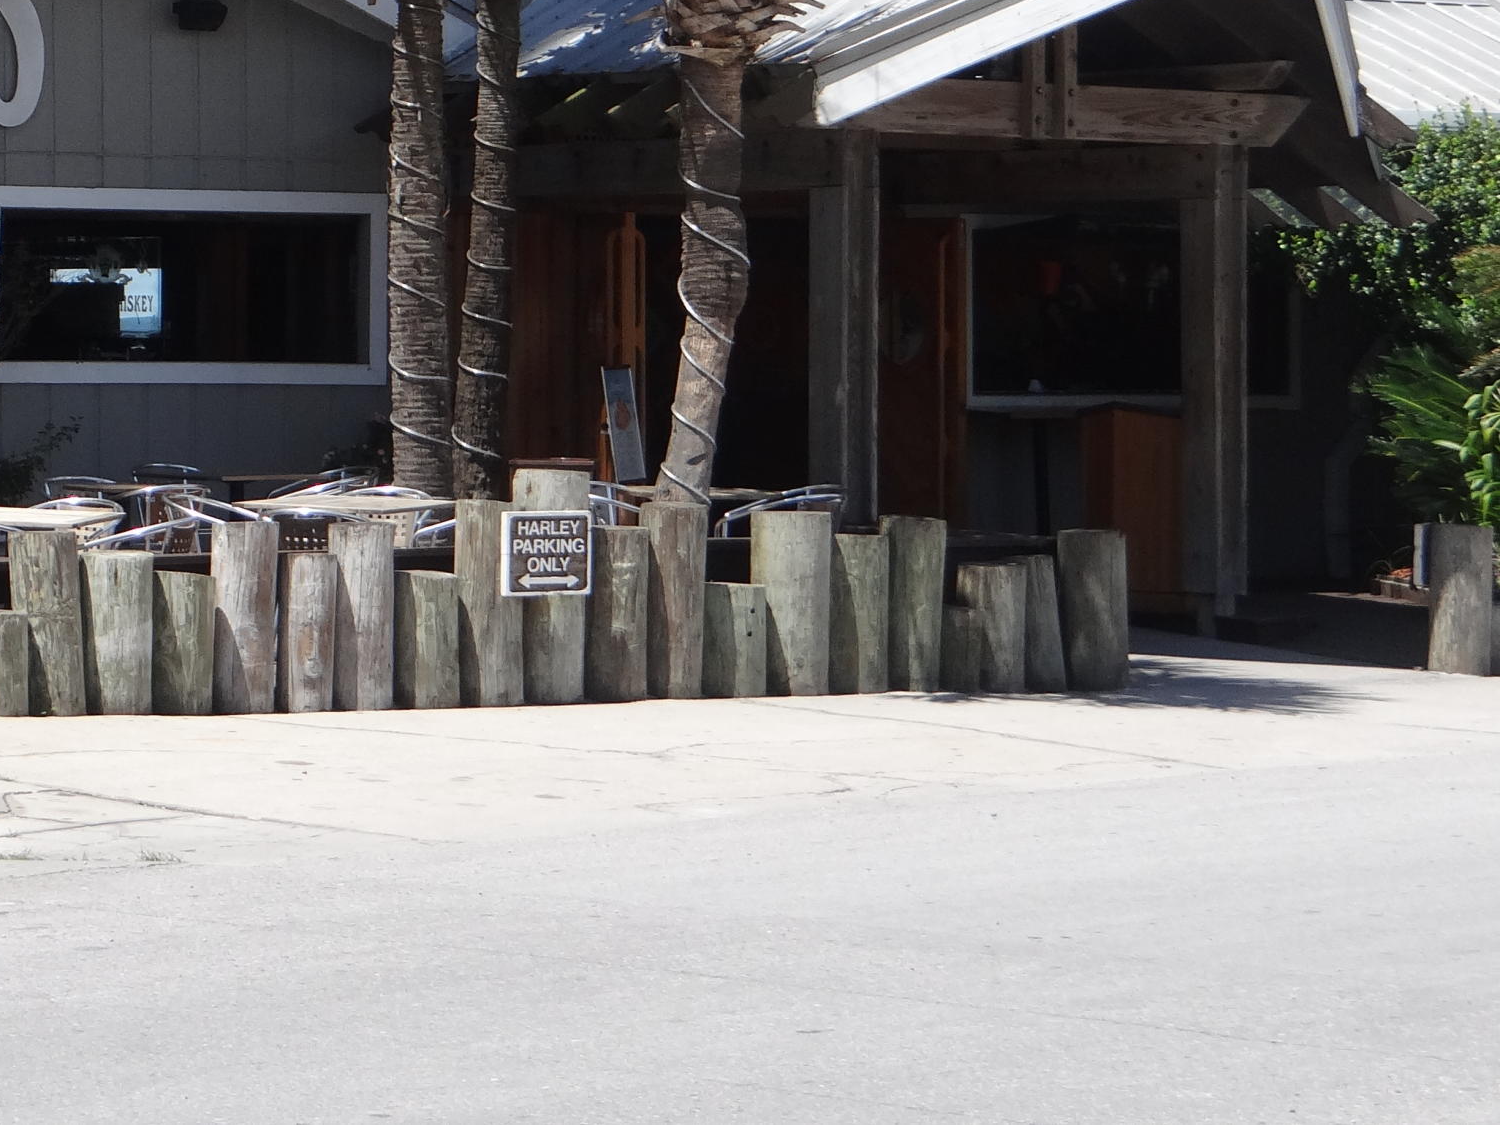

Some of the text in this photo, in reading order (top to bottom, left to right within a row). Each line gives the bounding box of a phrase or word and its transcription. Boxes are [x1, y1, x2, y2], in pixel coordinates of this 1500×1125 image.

[518, 520, 580, 535] HARLEY
[513, 538, 585, 554] PARKING
[527, 557, 570, 572] ONLY
